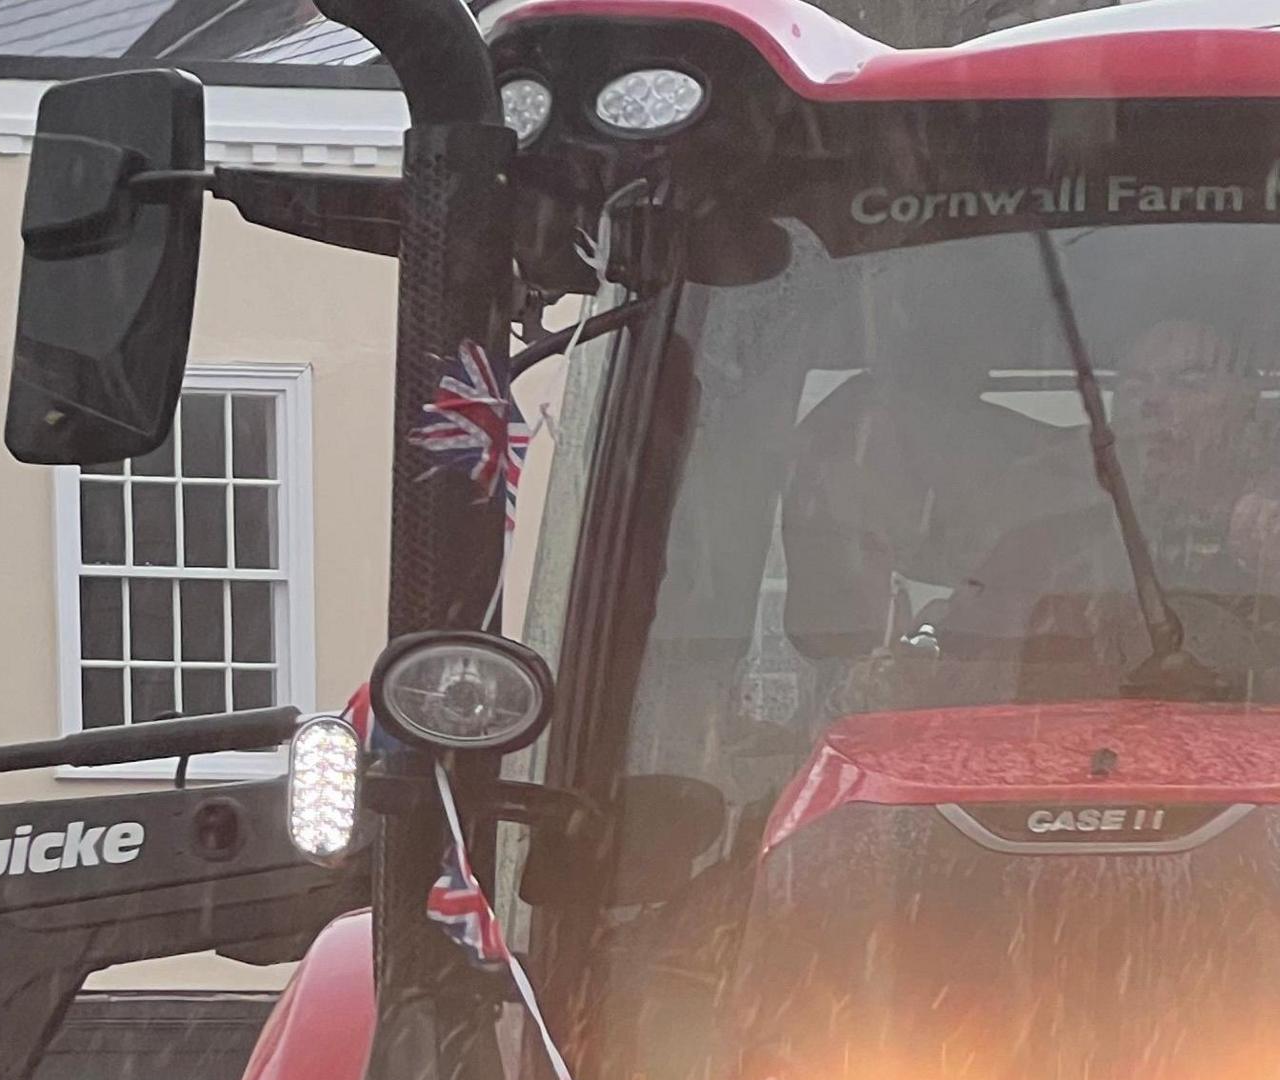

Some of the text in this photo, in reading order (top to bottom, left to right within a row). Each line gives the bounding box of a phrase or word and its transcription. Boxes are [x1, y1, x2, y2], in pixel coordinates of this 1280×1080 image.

[851, 175, 1086, 225] Cornwall
[1107, 175, 1244, 213] Farm
[1027, 809, 1127, 833] CASE
